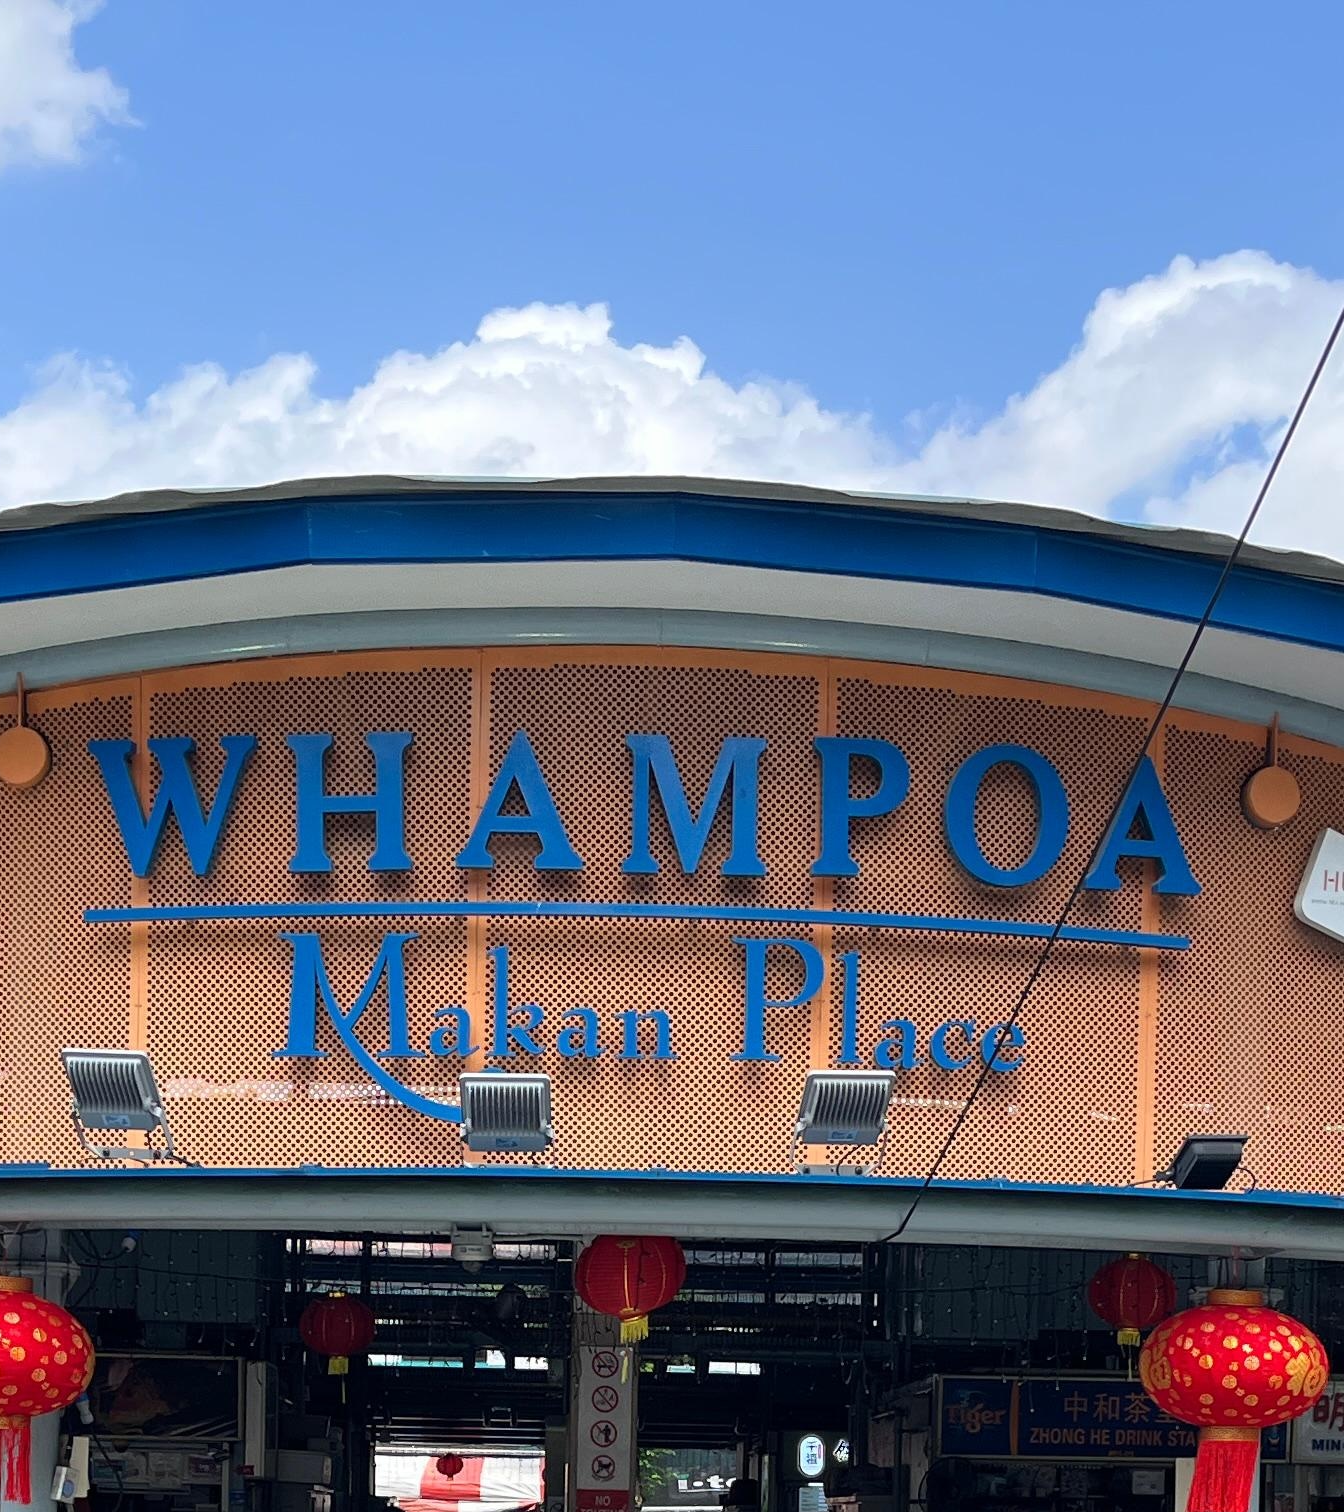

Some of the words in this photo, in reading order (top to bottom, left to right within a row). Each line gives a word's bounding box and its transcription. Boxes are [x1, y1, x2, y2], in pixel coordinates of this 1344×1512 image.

[85, 729, 1202, 896] WHAMPOA
[272, 932, 676, 1121] Makan
[732, 936, 1026, 1073] Place
[946, 1396, 1007, 1434] Tiger
[1029, 1427, 1085, 1446] ZHONG
[1090, 1428, 1111, 1446] HE
[1115, 1429, 1164, 1447] DRINK
[1167, 1430, 1197, 1447] STA
[595, 1495, 612, 1505] NO
